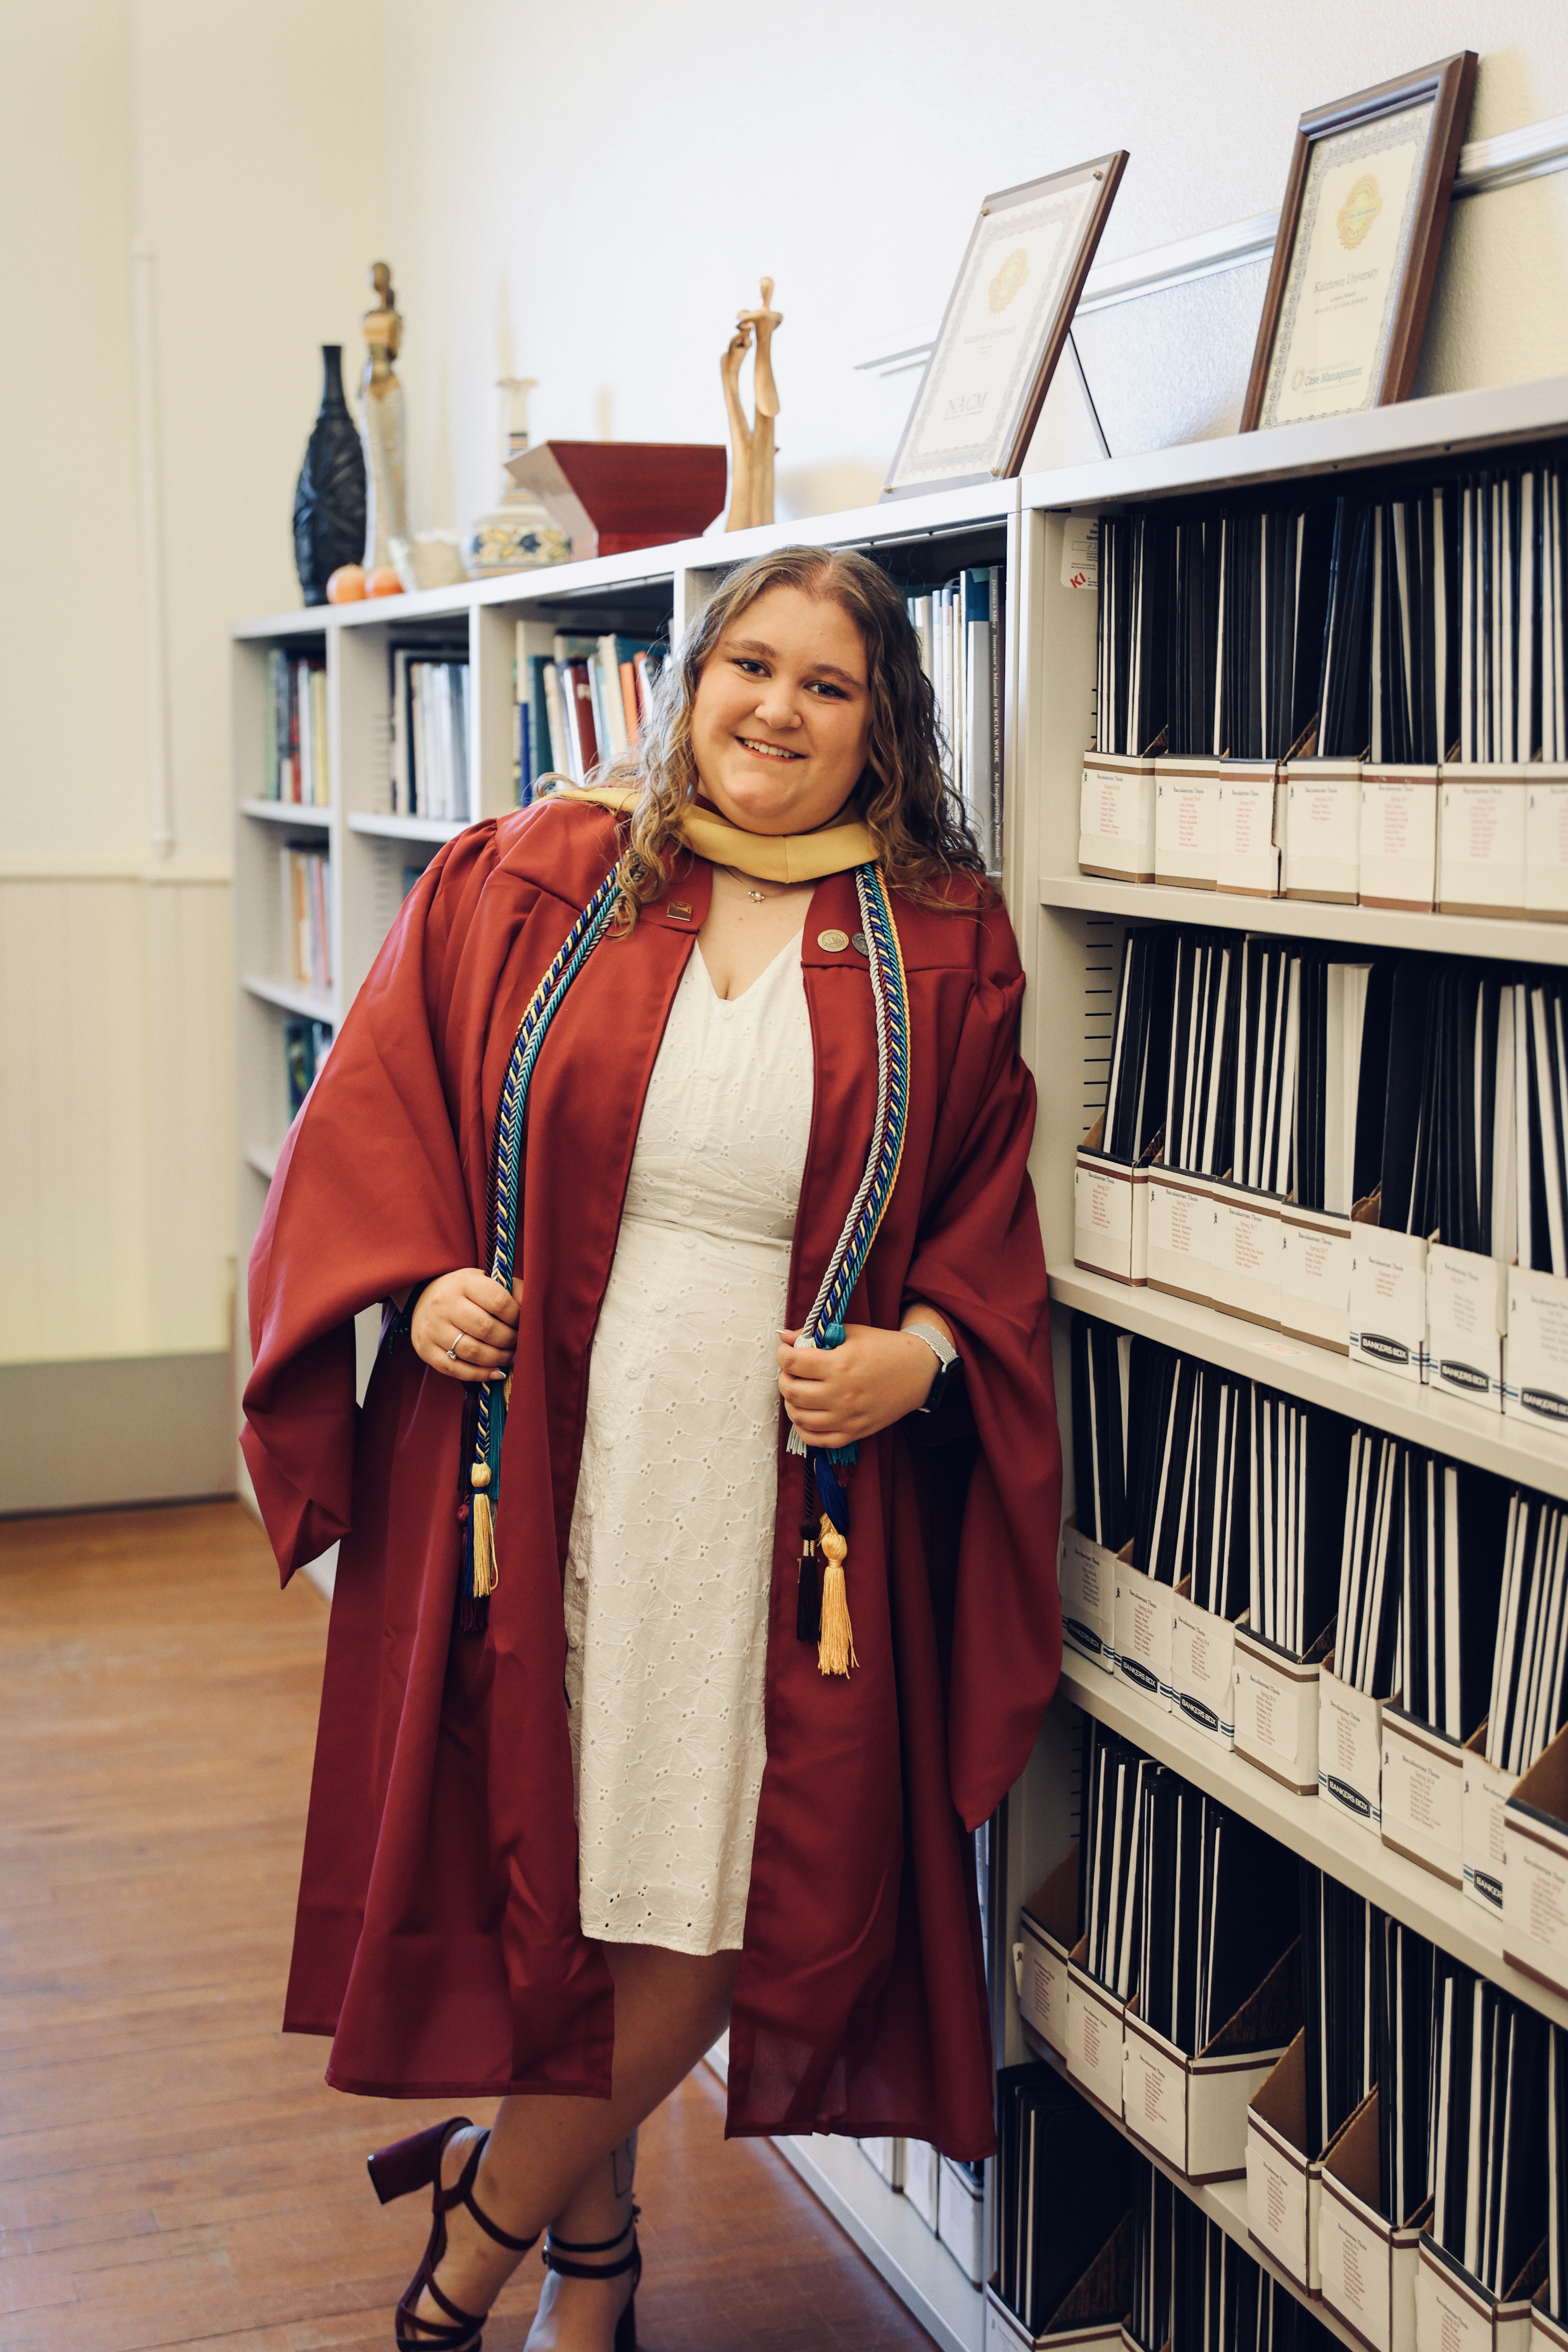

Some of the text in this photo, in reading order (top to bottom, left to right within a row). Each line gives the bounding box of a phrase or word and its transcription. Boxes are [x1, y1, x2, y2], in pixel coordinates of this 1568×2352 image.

[1346, 267, 1380, 285] University
[1305, 365, 1363, 386] Case Management
[1070, 572, 1086, 589] KI
[994, 772, 999, 782] An
[1088, 1171, 1115, 1184] Baccalaureate Thesis
[1165, 1188, 1198, 1202] Baccalaureate Thesis
[1176, 1199, 1186, 1208] Spring
[1228, 1207, 1262, 1223] Baccalaureate Thesis
[1240, 1220, 1250, 1229] Spring
[1363, 1338, 1407, 1359] BANKERS BOX
[1442, 1365, 1487, 1387] BANKERS BOX
[1558, 1403, 1568, 1415] BO
[1129, 1588, 1157, 1609] Baccalaureate Thesis
[1138, 1603, 1147, 1613] Spring
[1178, 1615, 1206, 1637] Baccalaureate Thesis
[1090, 1637, 1100, 1649] BOX
[1195, 1634, 1204, 1644] Spring
[1123, 1661, 1156, 1688] BANKERS BOX
[1249, 1674, 1280, 1696] Baccalaureate Thesis
[1260, 1689, 1269, 1700] Spring
[1182, 1699, 1216, 1726] BANKERS BOX
[1329, 1781, 1368, 1812] BANKERS BOX
[1476, 1876, 1503, 1899] BANKER
[1337, 2222, 1367, 2251] Baccalaureate Thesis
